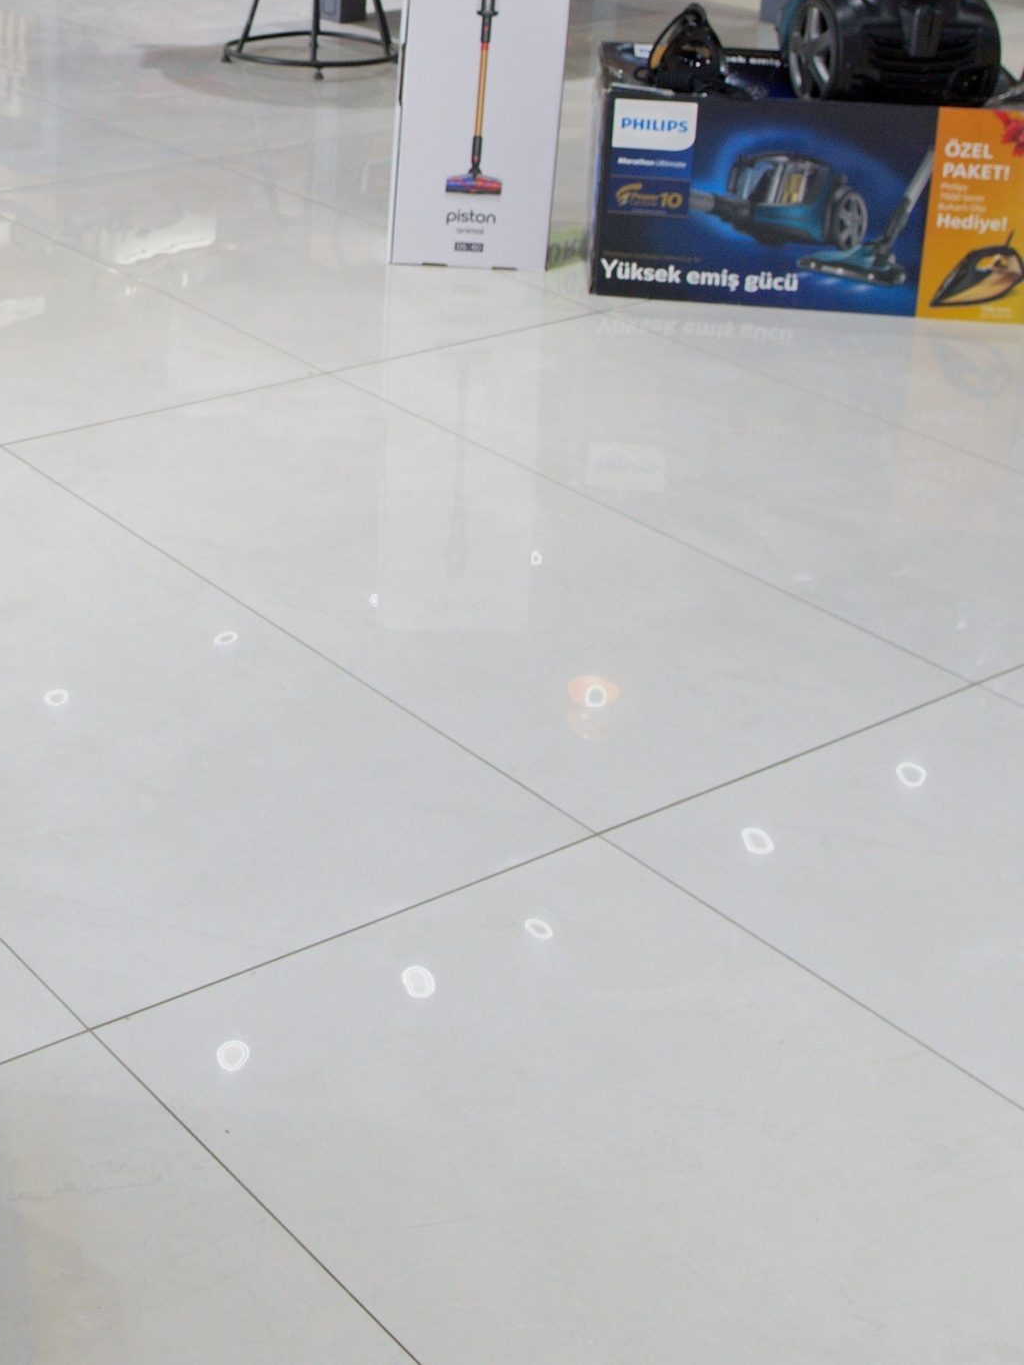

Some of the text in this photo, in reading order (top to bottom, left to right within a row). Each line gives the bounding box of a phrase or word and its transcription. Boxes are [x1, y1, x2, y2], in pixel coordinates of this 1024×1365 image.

[620, 117, 689, 133] PHILIPS
[944, 137, 994, 160] ÖZEL
[942, 161, 1010, 181] PAKET!
[660, 191, 683, 209] 10
[446, 209, 497, 225] piston
[936, 213, 1009, 235] Hediye!
[600, 257, 682, 284] Yüksek
[686, 268, 740, 292] emiş
[744, 271, 799, 293] gücü
